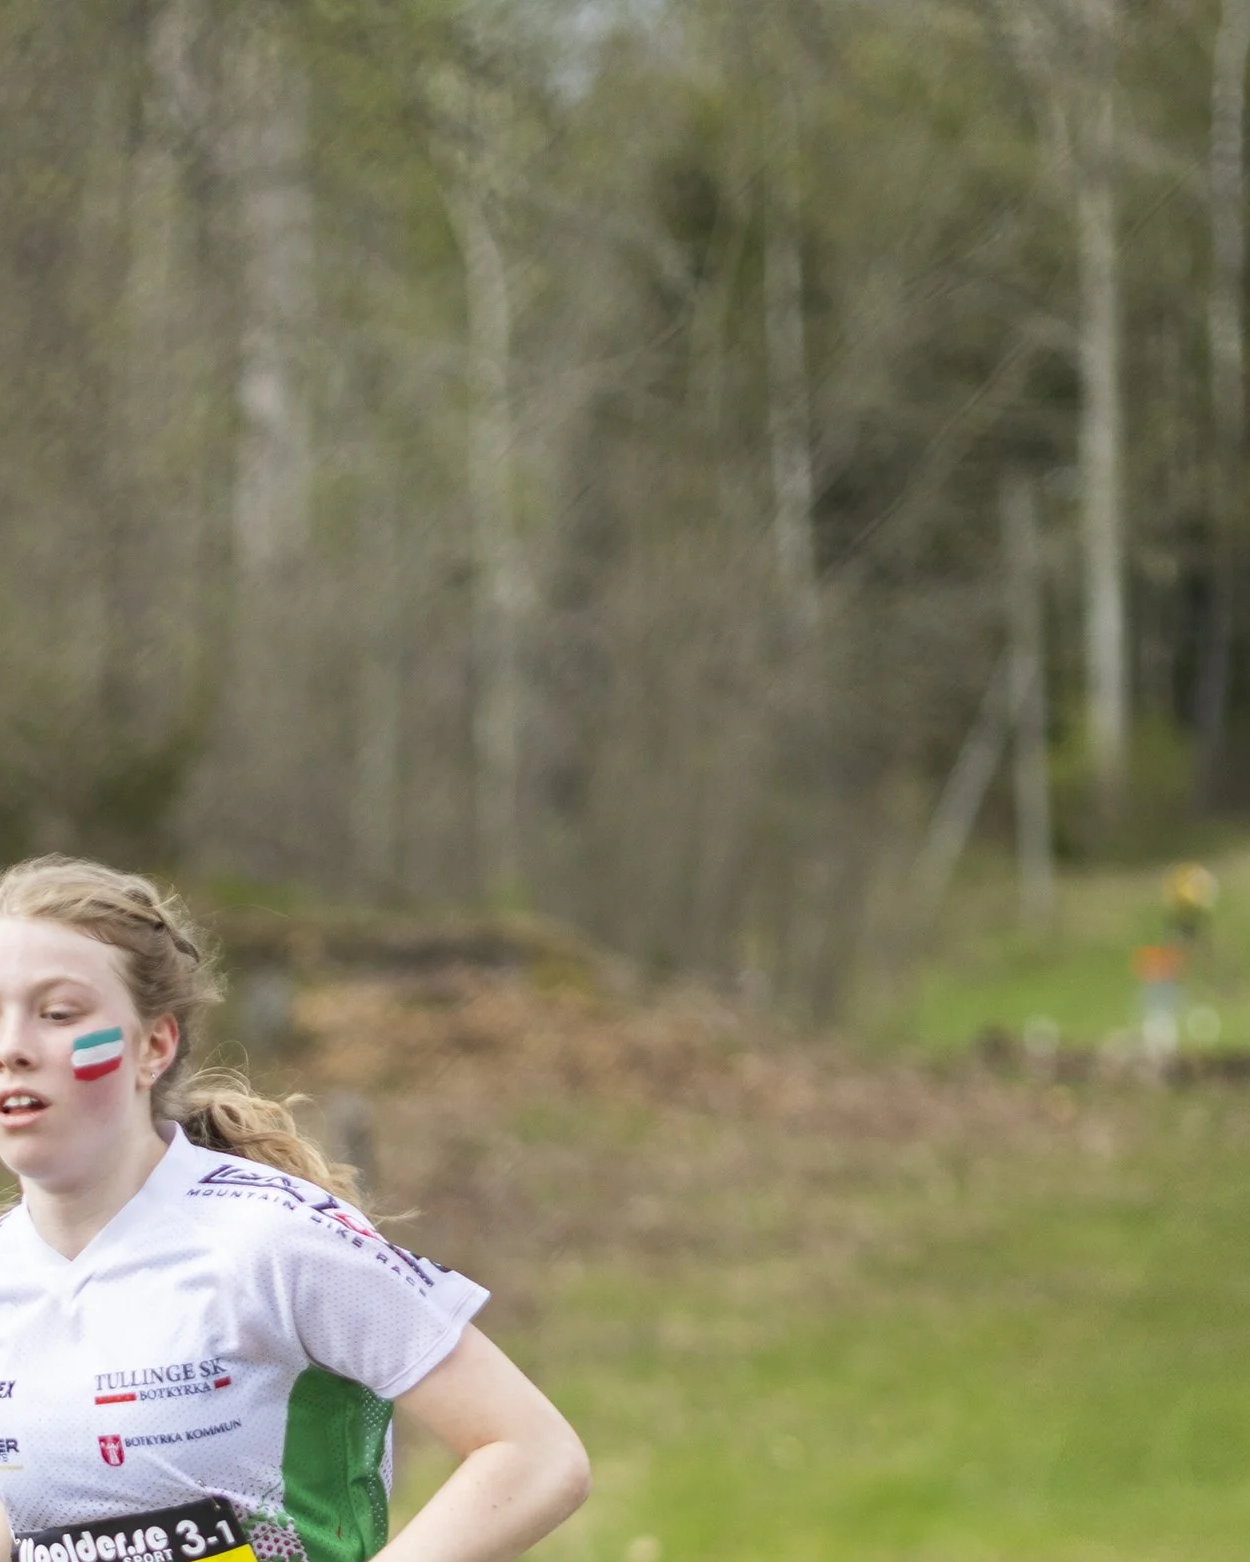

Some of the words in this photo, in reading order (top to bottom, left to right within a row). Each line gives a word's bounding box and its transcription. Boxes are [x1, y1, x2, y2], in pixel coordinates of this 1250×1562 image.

[186, 1188, 297, 1211] MOUNTAIN
[94, 1362, 196, 1391] TULLINGE
[198, 1357, 227, 1379] SK
[138, 1381, 212, 1401] BOTKYRKA
[124, 1432, 183, 1448] BOTKYRKA
[185, 1418, 243, 1442] KOMMUN
[175, 1519, 238, 1557] 3-1
